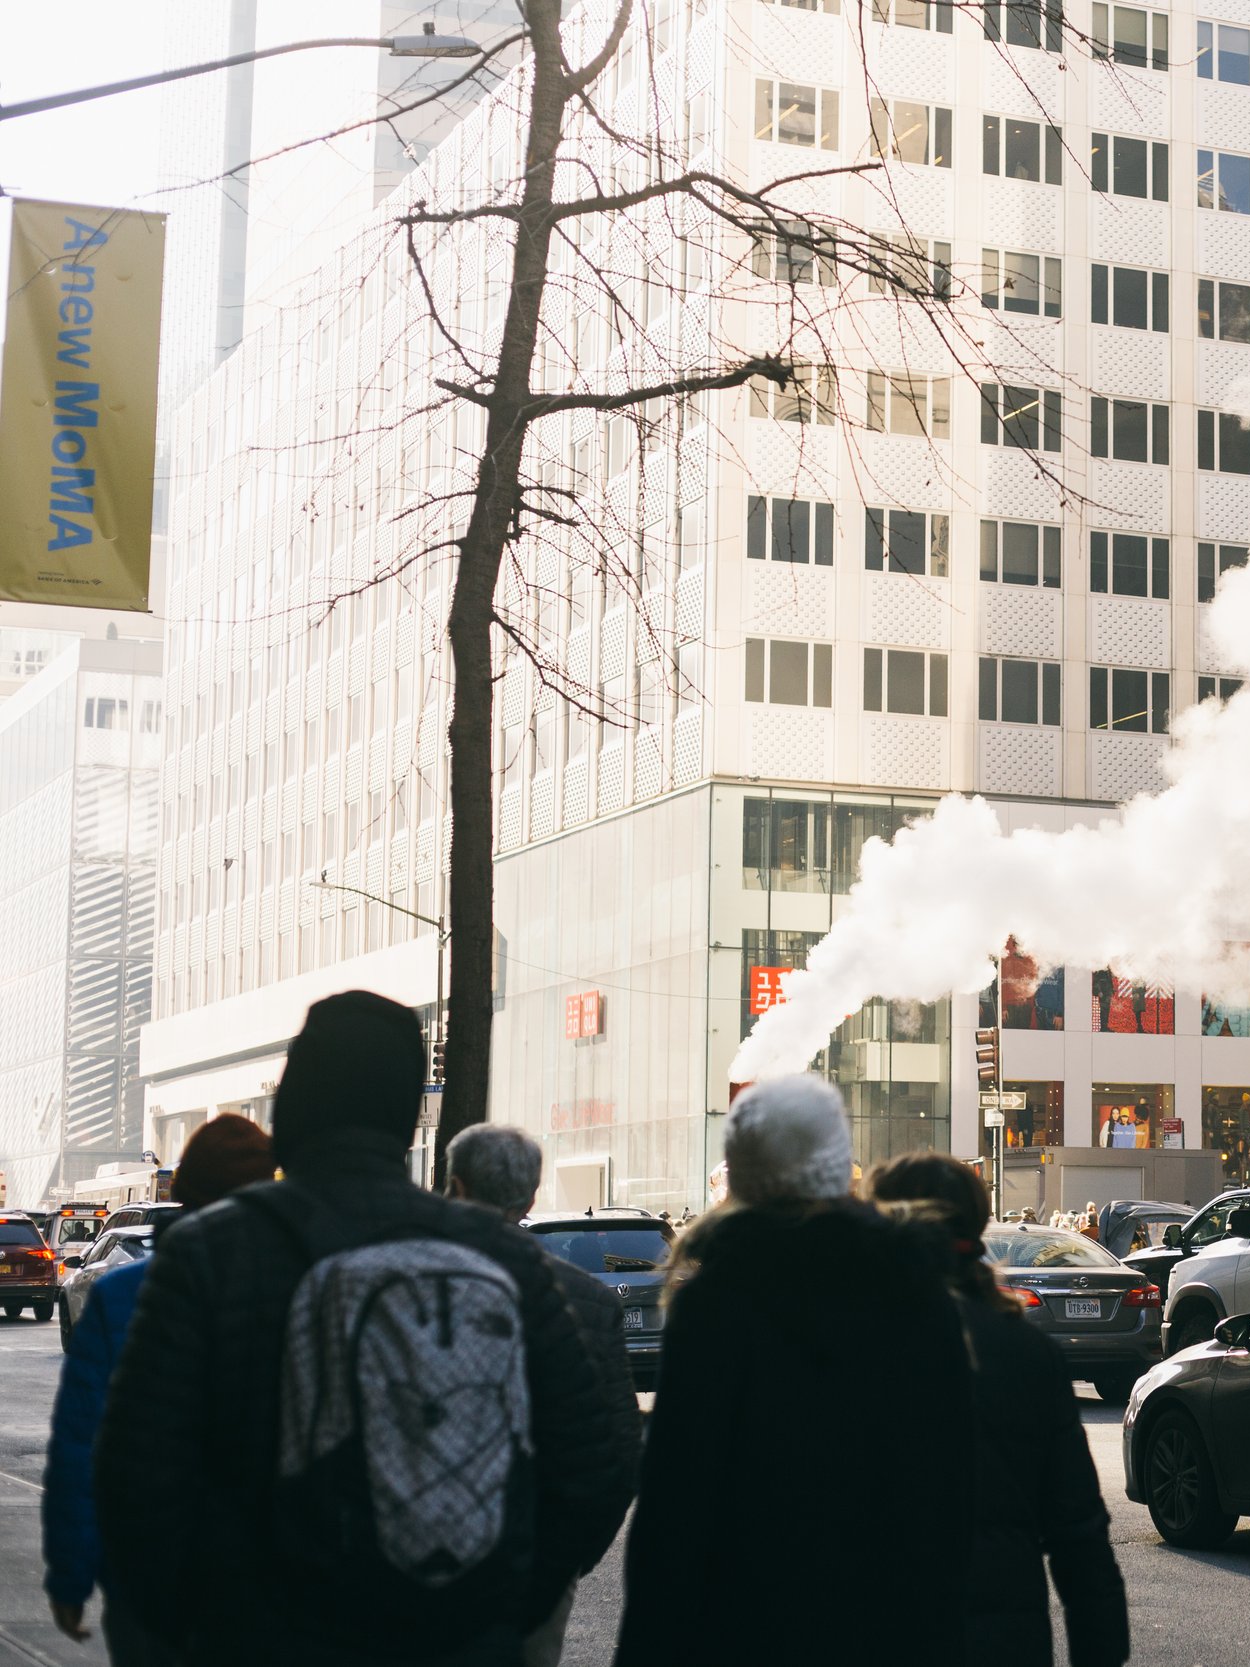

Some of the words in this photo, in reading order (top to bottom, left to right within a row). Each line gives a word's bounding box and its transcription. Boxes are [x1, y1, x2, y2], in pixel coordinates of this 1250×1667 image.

[47, 380, 101, 552] MoMA
[583, 995, 596, 1012] UNI
[583, 1013, 597, 1033] QLO
